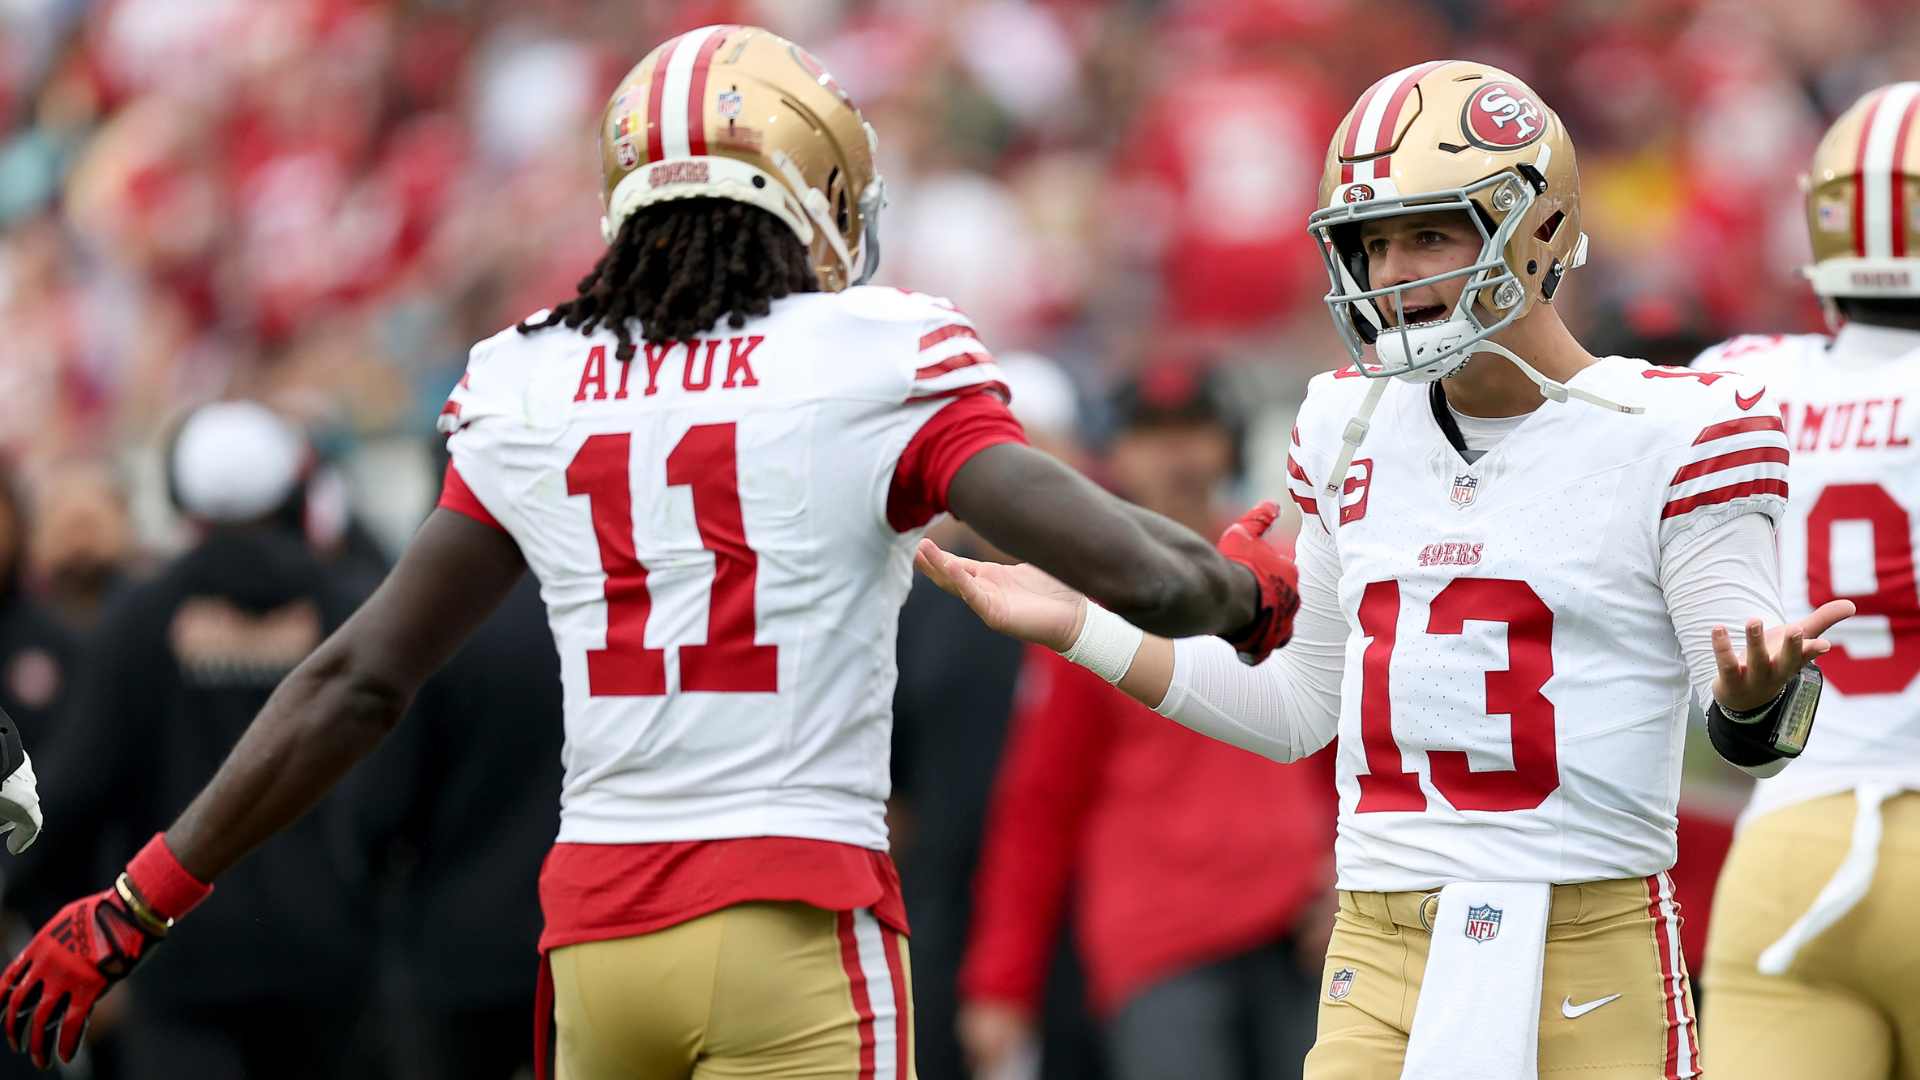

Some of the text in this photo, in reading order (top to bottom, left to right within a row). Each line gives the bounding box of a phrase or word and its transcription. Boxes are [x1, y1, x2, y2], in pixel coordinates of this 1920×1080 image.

[1480, 86, 1541, 140] SF
[574, 336, 764, 402] AIYUK
[1453, 486, 1471, 502] NFL
[566, 422, 778, 696] 11
[1418, 542, 1484, 567] 49ERS
[1806, 483, 1920, 696] 9
[1355, 577, 1560, 814] 13
[1468, 920, 1496, 939] NFL
[1331, 981, 1347, 996] NFL
